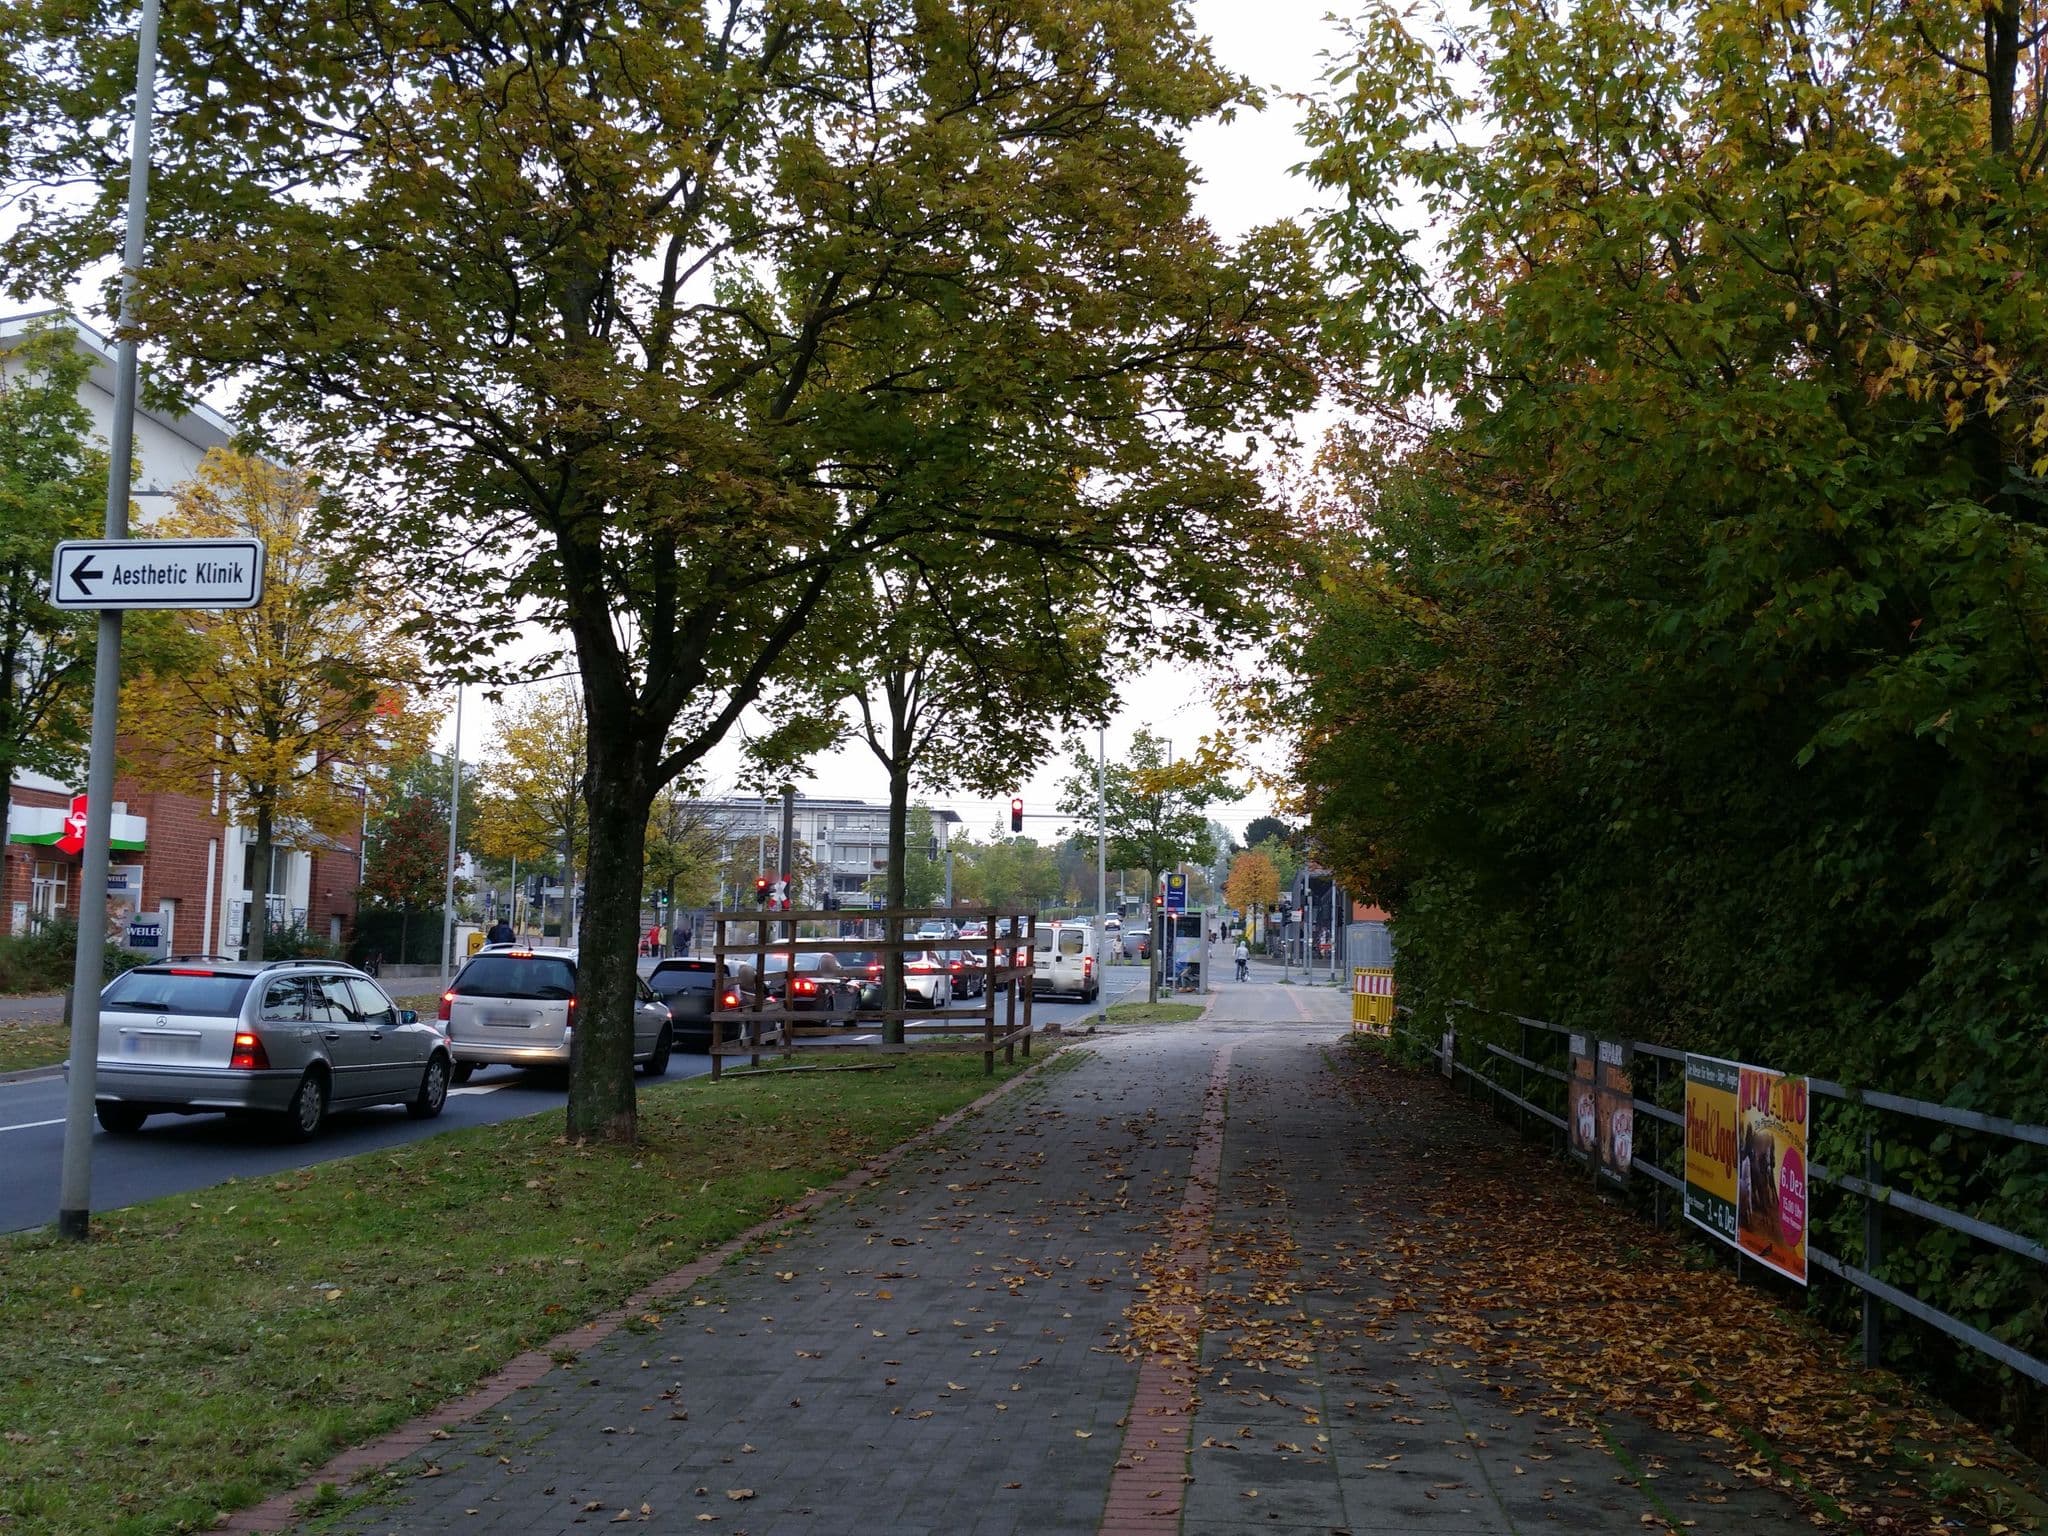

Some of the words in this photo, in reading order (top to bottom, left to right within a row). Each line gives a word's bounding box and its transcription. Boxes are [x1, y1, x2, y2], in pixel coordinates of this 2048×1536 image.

[112, 563, 188, 585] Aesthetic
[195, 561, 243, 584] Klinik
[126, 927, 163, 936] WEILER
